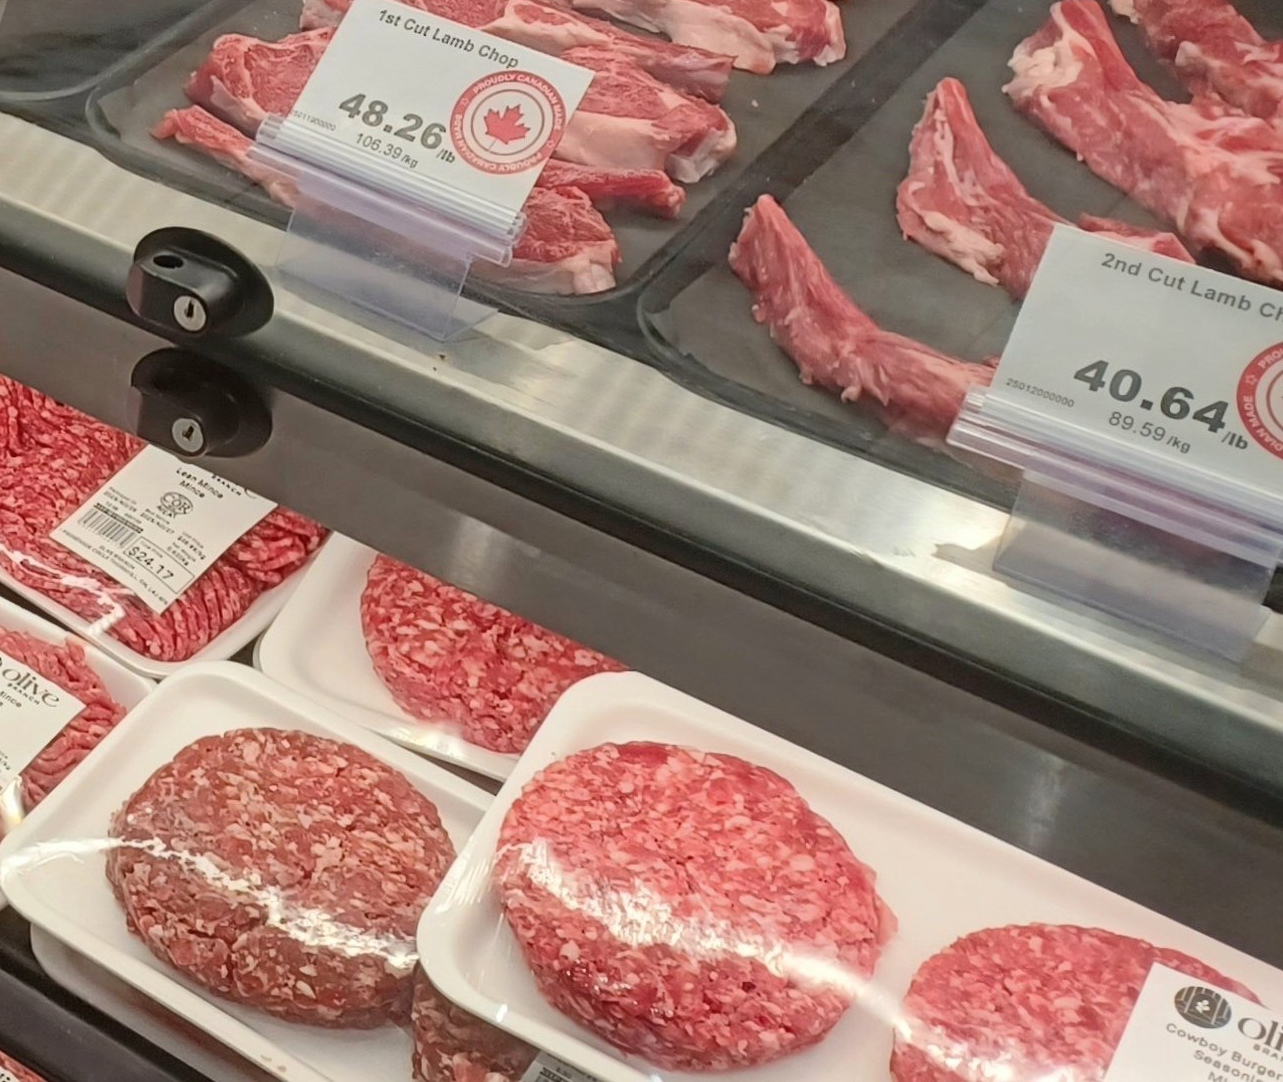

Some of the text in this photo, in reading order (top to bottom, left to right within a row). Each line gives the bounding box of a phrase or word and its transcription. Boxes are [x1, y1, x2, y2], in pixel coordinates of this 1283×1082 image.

[378, 9, 519, 69] 1st Cut Lamb Chop
[473, 74, 516, 94] PROUDLY
[516, 74, 557, 105] CANADIAN
[339, 93, 456, 165] 48.26 /lb
[356, 132, 418, 170] 106.39 /kg
[1101, 252, 1143, 277] 2nd
[1148, 267, 1185, 291] Cut
[1190, 280, 1252, 312] Lamb
[1073, 359, 1249, 450] 40.64 /lb
[1108, 411, 1191, 455] 89.59 /kg
[175, 468, 224, 499] Lean Mince
[178, 479, 205, 498] Mince
[127, 546, 174, 579] $24.17
[1, 668, 59, 706] olive
[6, 682, 40, 705] BRANCH
[1166, 1023, 1227, 1057] Cowboy
